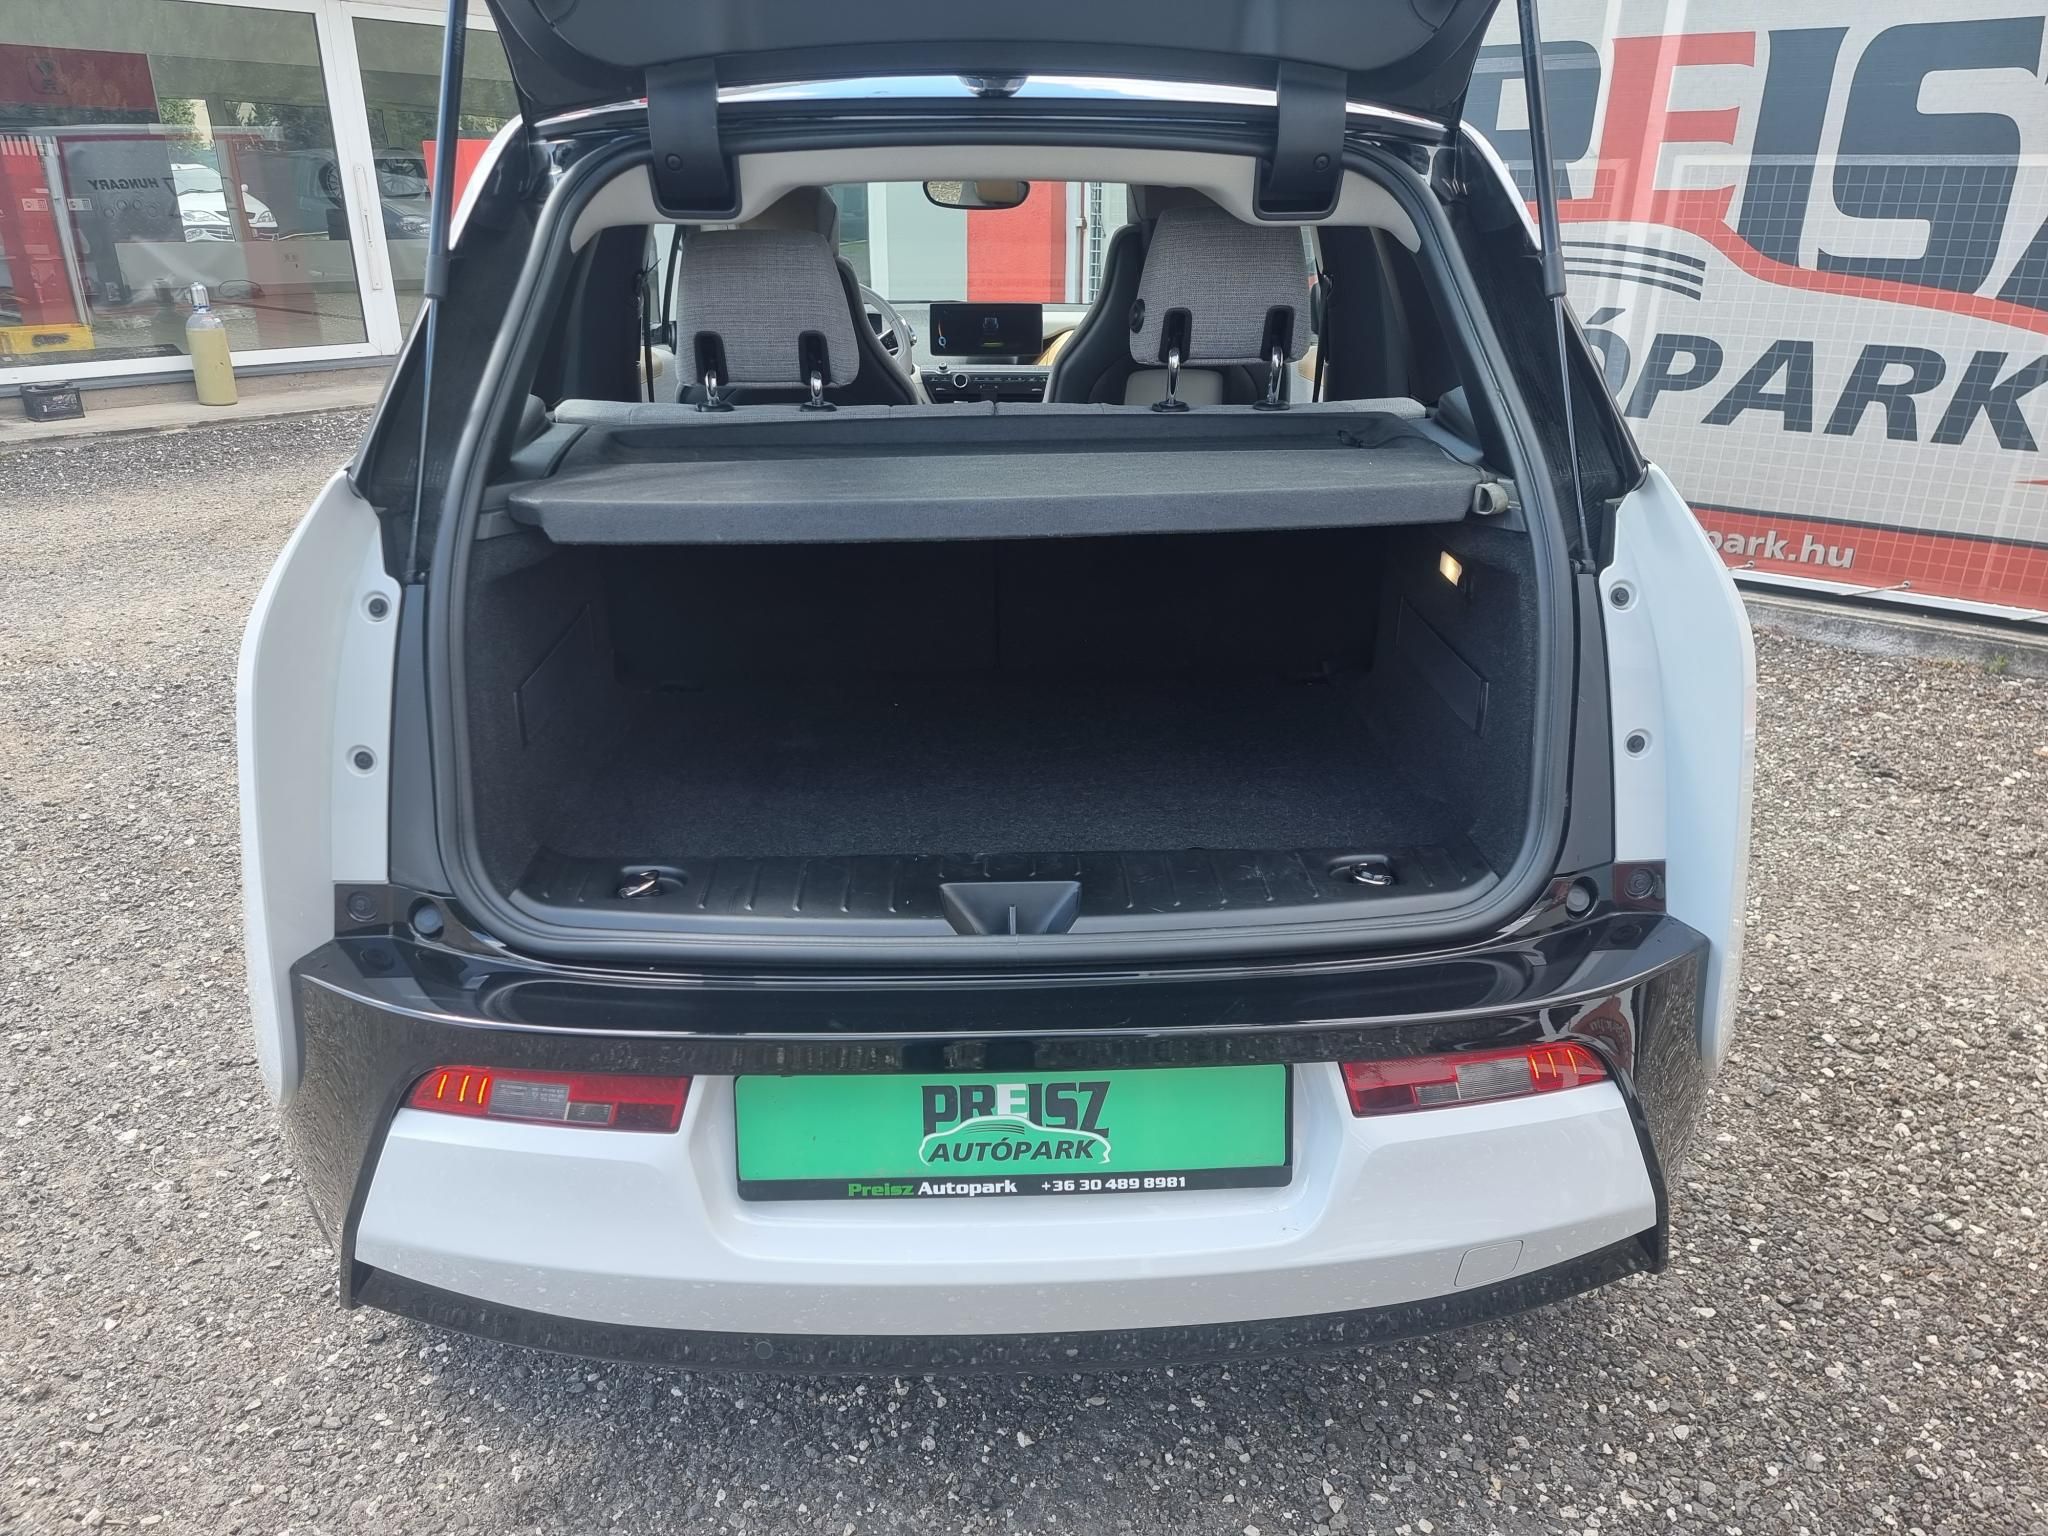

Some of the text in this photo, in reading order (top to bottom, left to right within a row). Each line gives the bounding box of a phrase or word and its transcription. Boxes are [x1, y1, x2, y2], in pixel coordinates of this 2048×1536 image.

[1460, 16, 2048, 312] REIS
[921, 1081, 1110, 1138] PREISZ
[927, 1137, 1096, 1162] AUTÓPARK
[848, 1176, 1186, 1197] Preisz Autopark +36 30 489 8981
